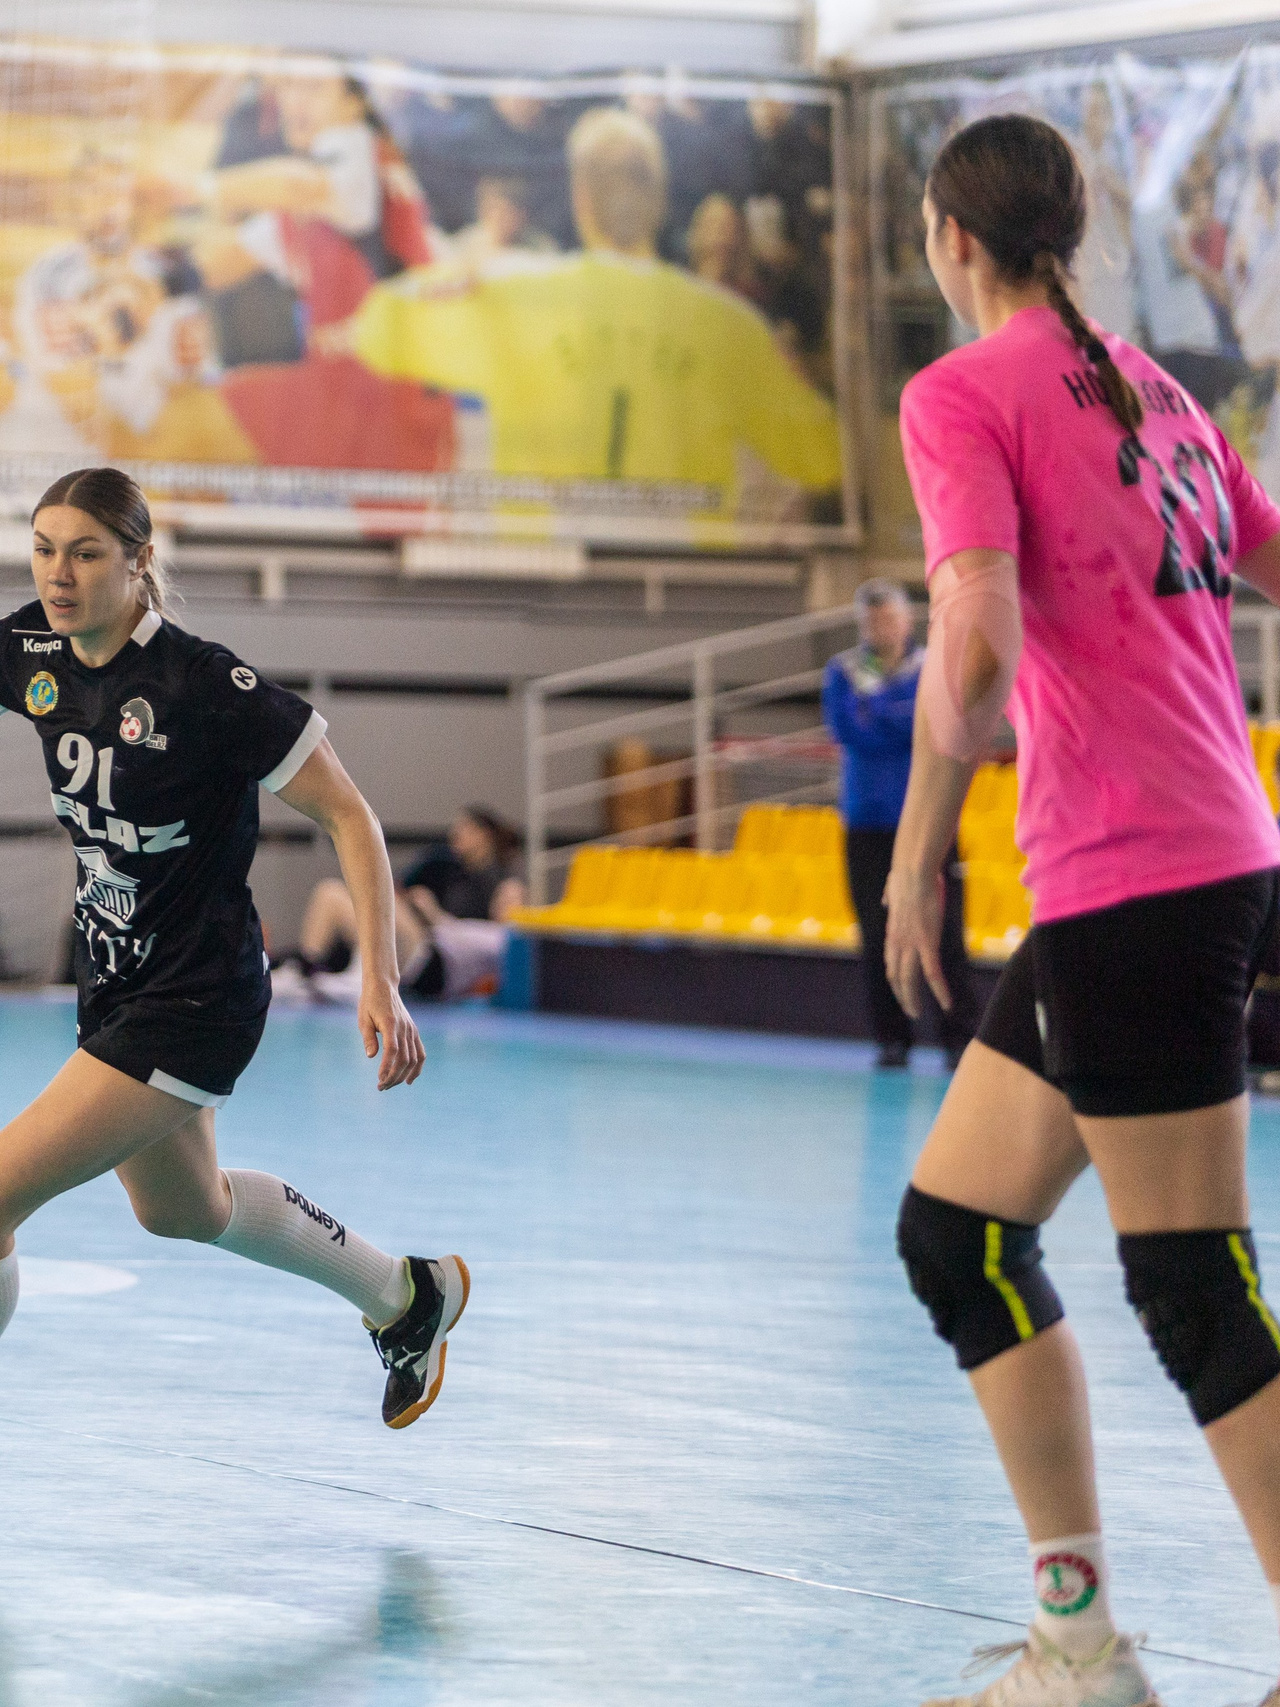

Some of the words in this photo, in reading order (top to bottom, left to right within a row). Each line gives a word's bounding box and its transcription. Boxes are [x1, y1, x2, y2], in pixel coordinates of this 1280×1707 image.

[23, 638, 62, 655] Kempa
[56, 732, 116, 811] 91
[51, 792, 190, 853] ELAZ
[283, 1183, 346, 1247] Kempa
